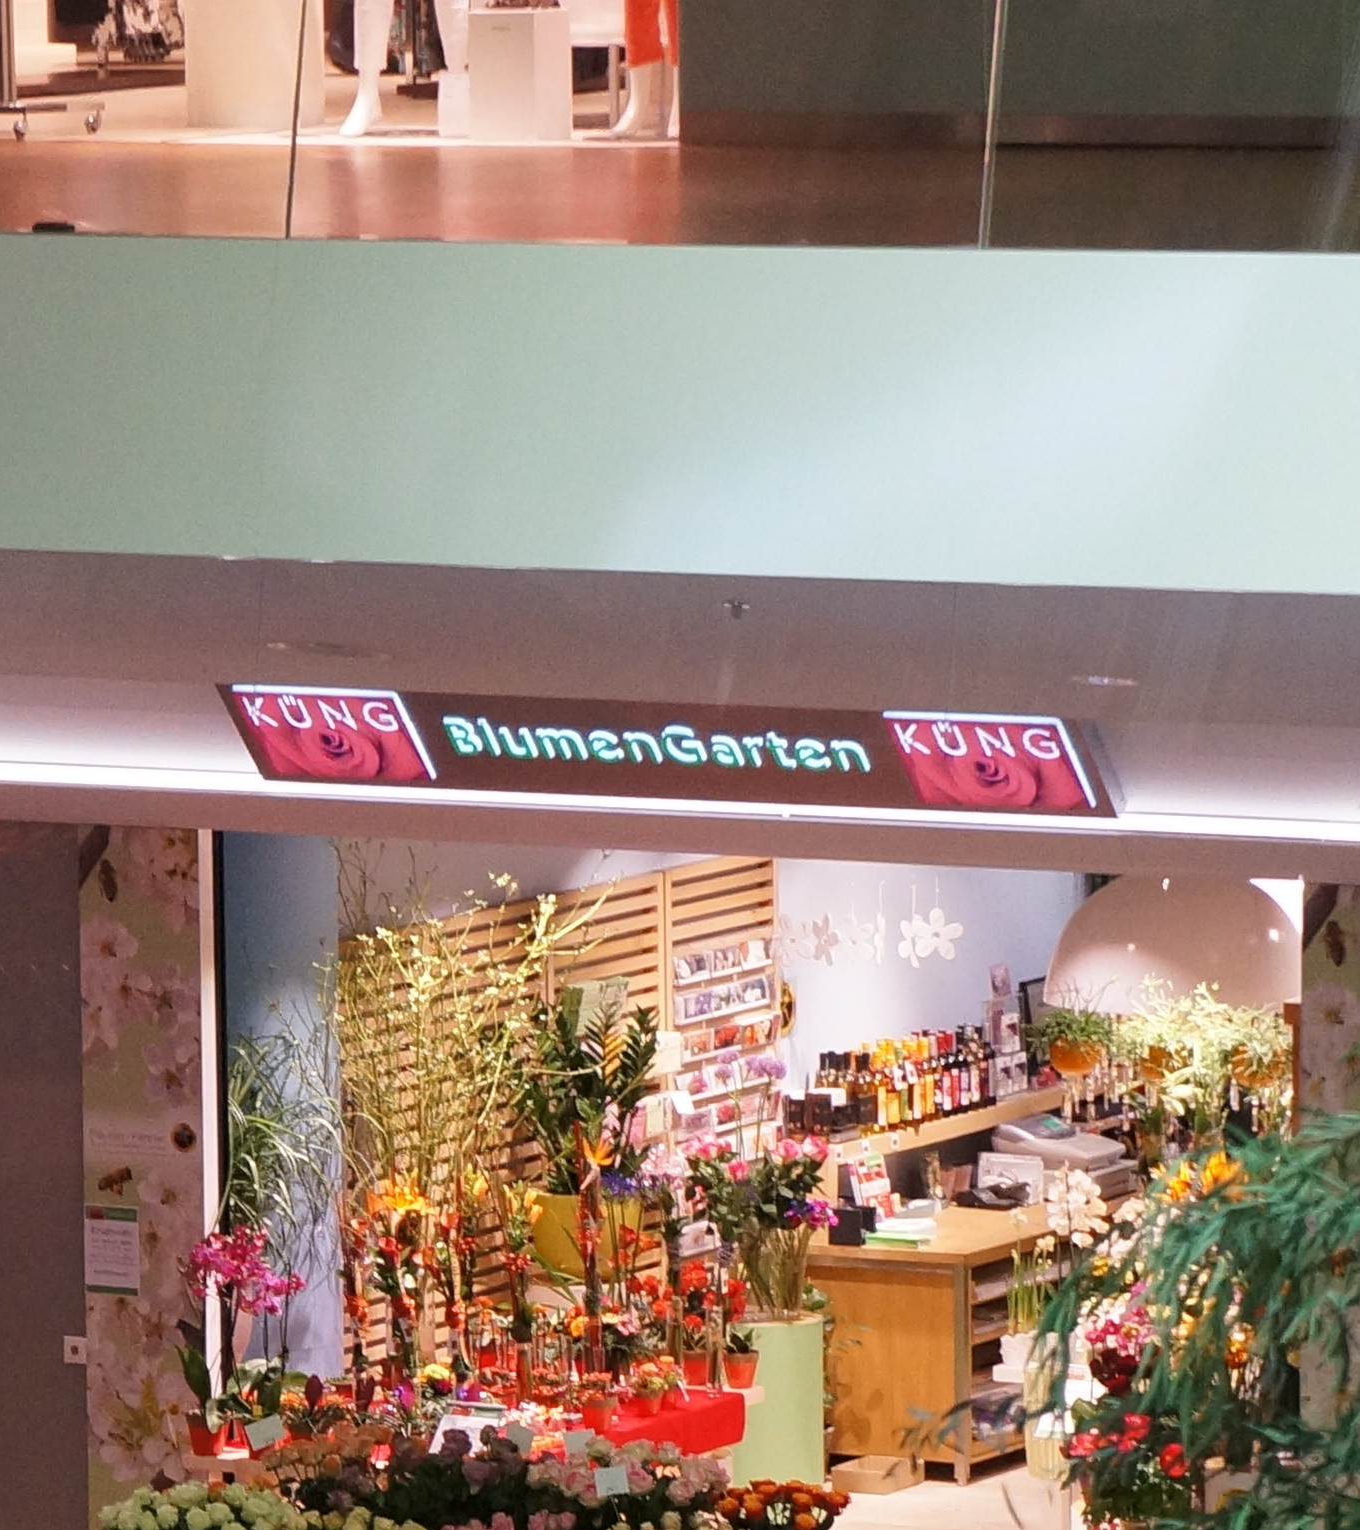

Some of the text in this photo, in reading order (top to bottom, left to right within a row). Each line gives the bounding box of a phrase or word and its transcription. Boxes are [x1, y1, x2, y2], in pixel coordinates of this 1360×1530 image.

[244, 693, 402, 733] KÜNG
[442, 715, 872, 774] BlumenGarten
[896, 719, 1063, 760] KÜNG
